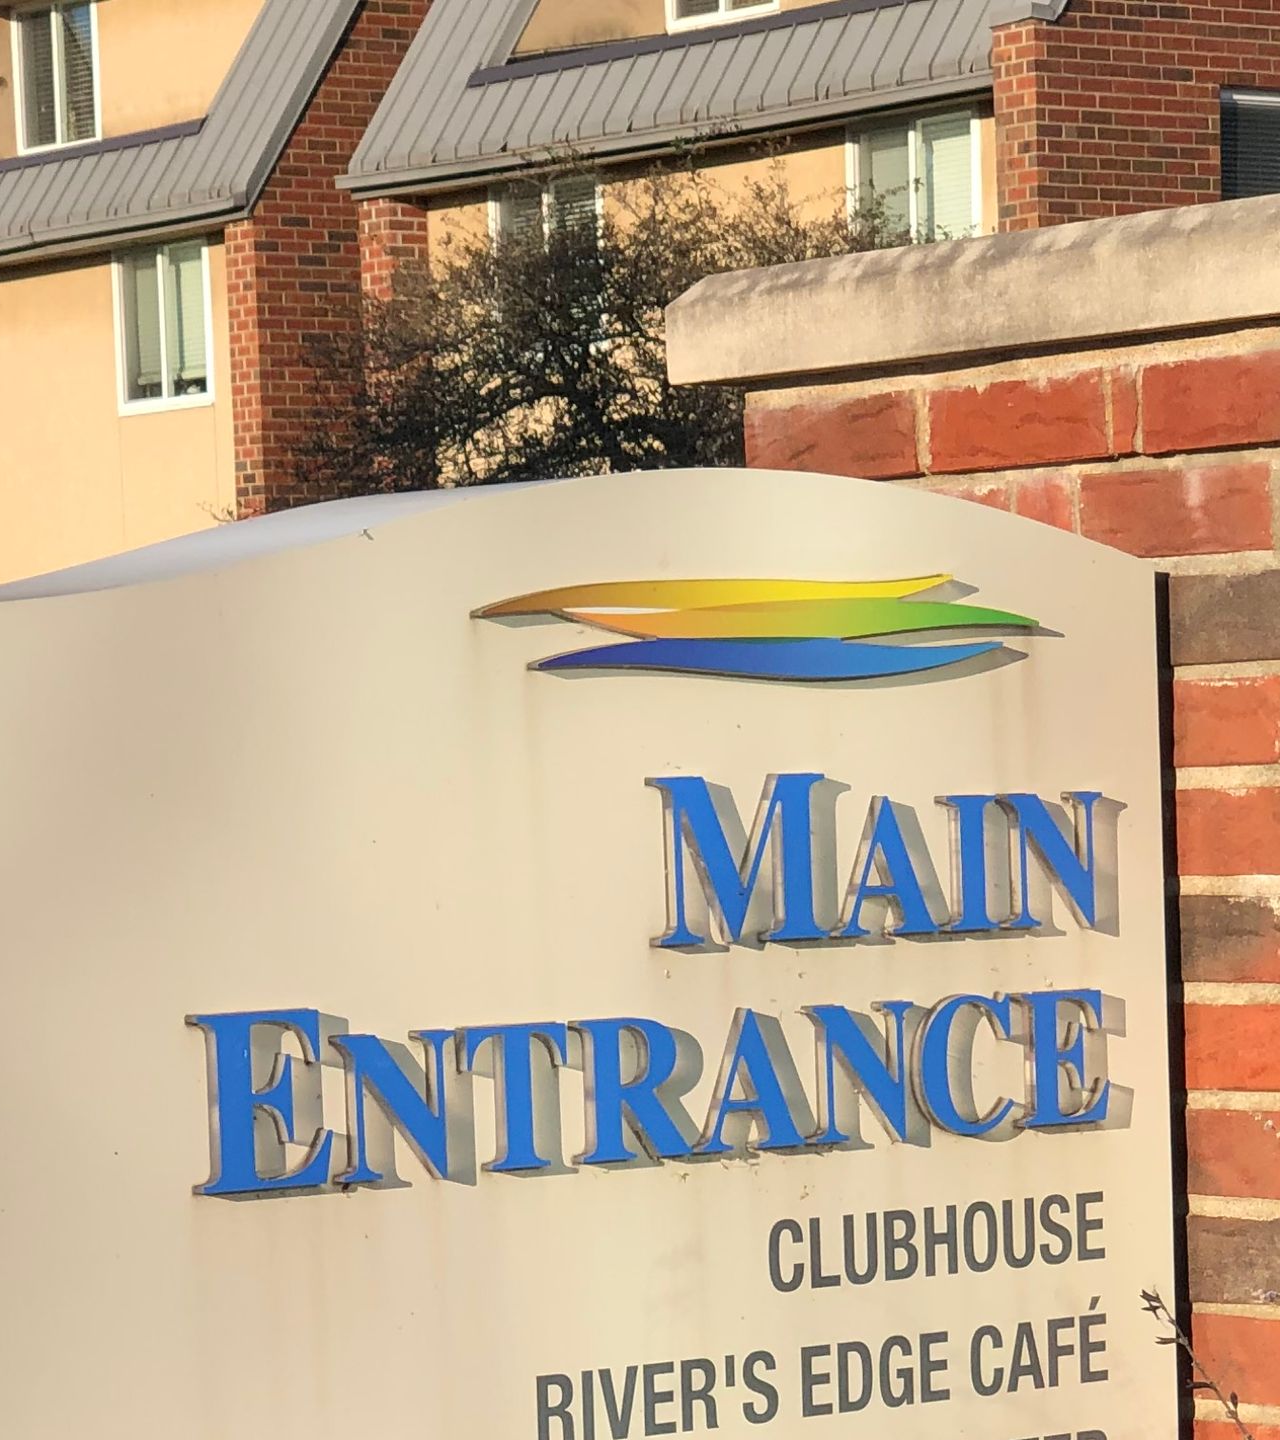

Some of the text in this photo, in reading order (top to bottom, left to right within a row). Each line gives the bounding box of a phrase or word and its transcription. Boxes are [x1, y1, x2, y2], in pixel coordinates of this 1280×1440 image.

[644, 772, 1104, 948] MAIN
[186, 988, 1112, 1197] ENTRANCE
[768, 1190, 1106, 1293] CLUBHOUSE
[800, 1331, 951, 1418] EDGE
[970, 1295, 1109, 1397] CAFÉ
